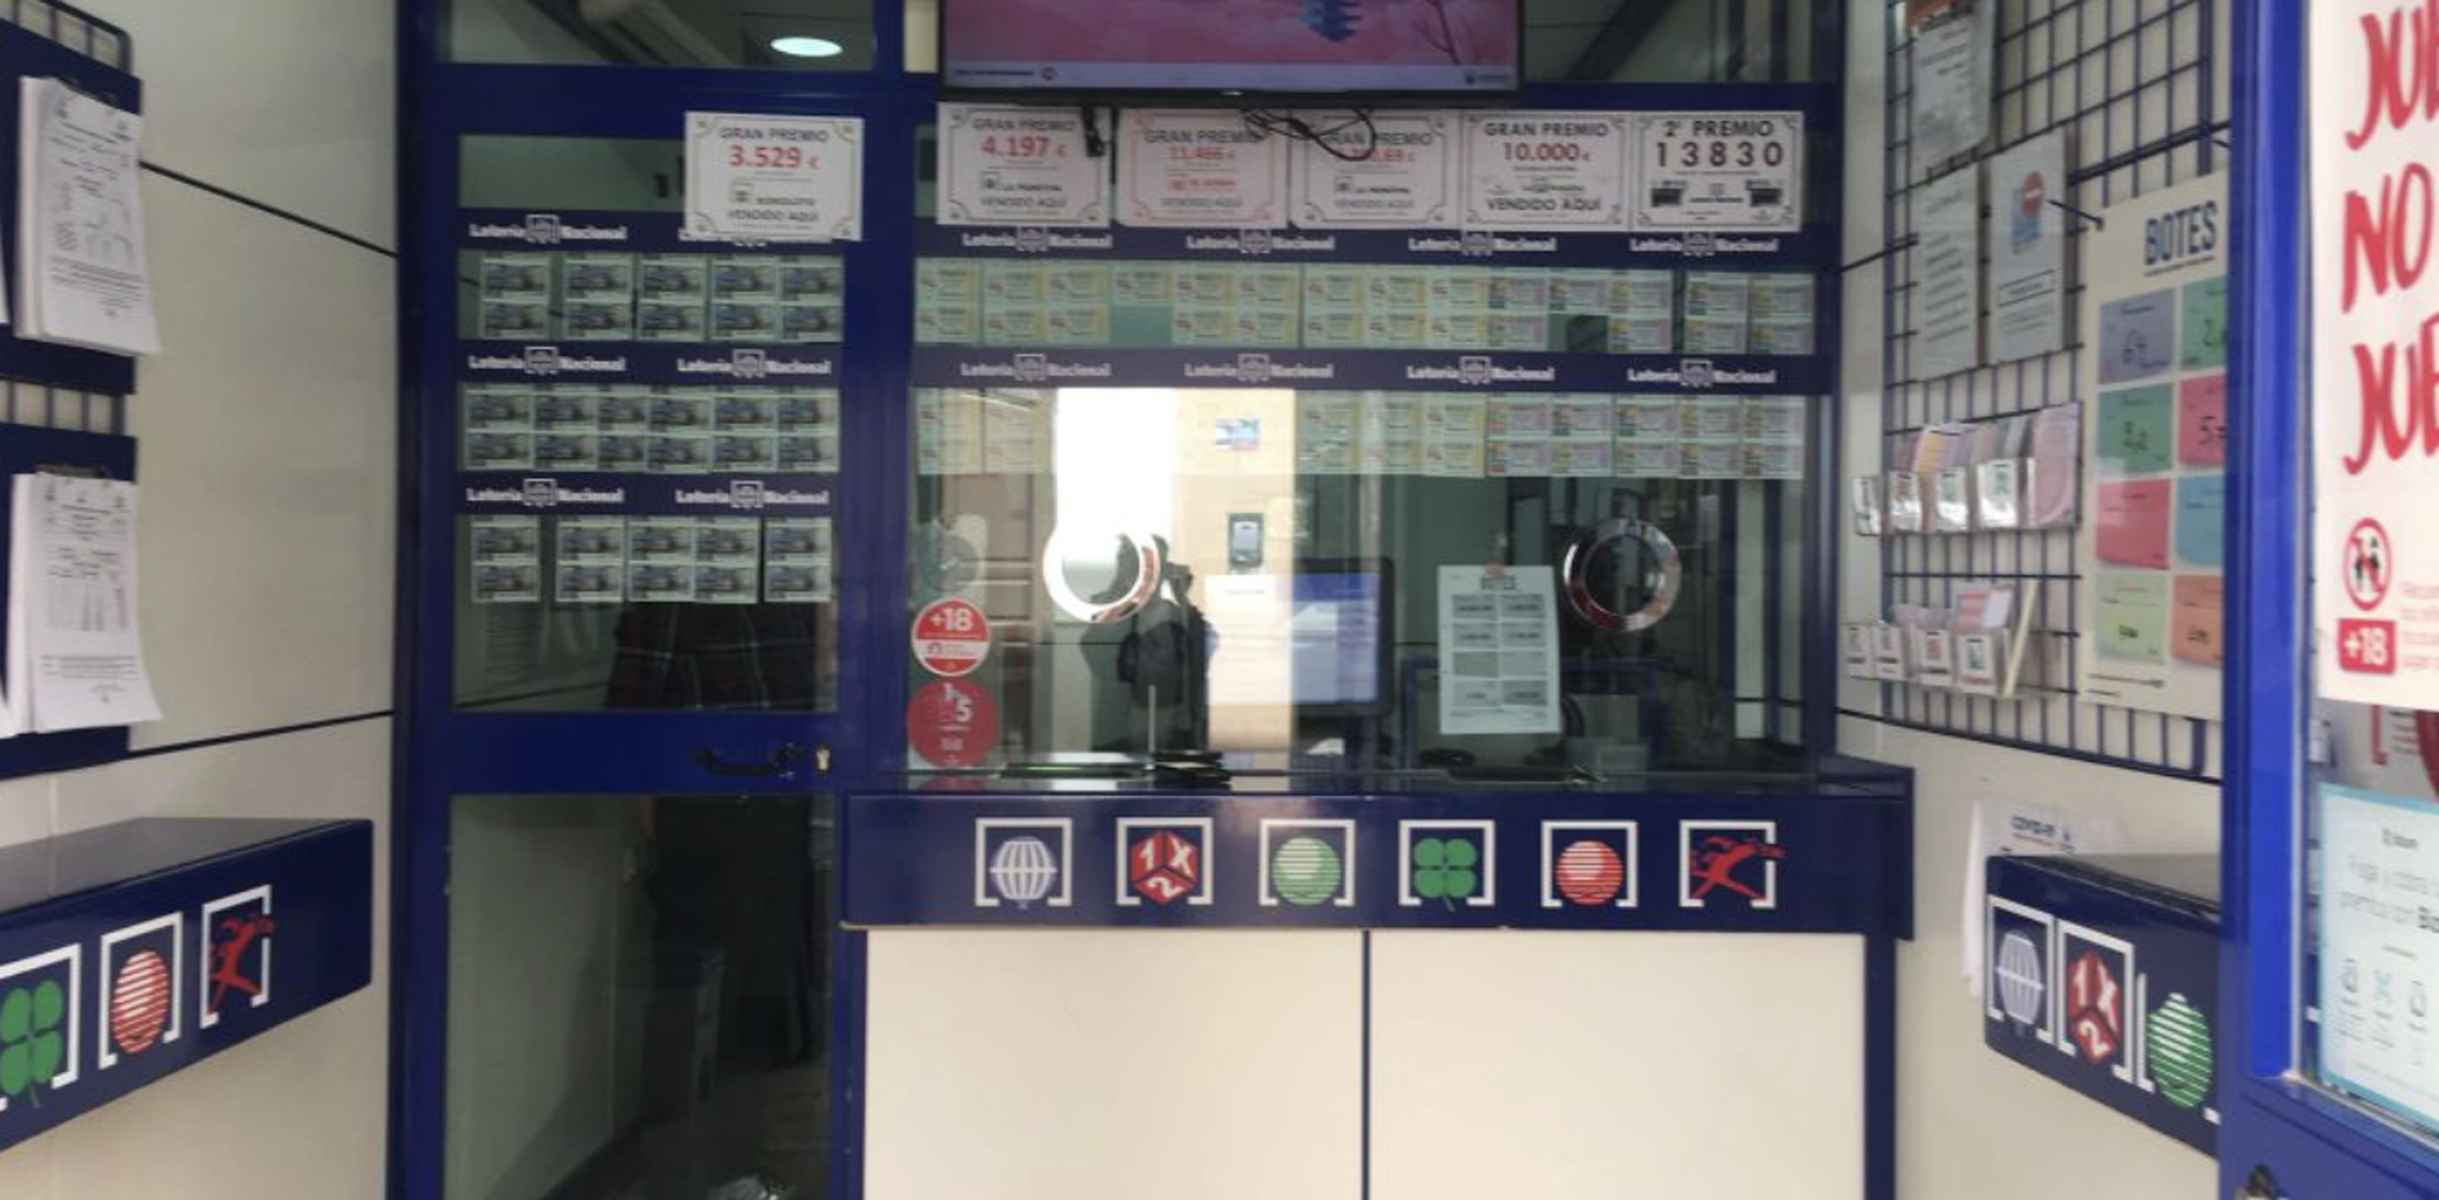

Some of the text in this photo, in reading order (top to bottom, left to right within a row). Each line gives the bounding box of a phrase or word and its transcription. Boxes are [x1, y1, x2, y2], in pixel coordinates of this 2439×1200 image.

[719, 127, 830, 143] GRAN PREMIO
[1485, 121, 1609, 138] GRAN PREMIO
[1692, 119, 1774, 137] PREMIO
[729, 144, 801, 168] 3.529
[981, 135, 1050, 157] 4.197
[1503, 142, 1581, 161] 10.000
[1656, 140, 1784, 168] 13830
[1487, 198, 1557, 211] VENDIDO
[2146, 201, 2216, 265] BOTES
[2341, 161, 2432, 312] NO
[928, 607, 974, 632] +18
[2345, 627, 2384, 666] +18
